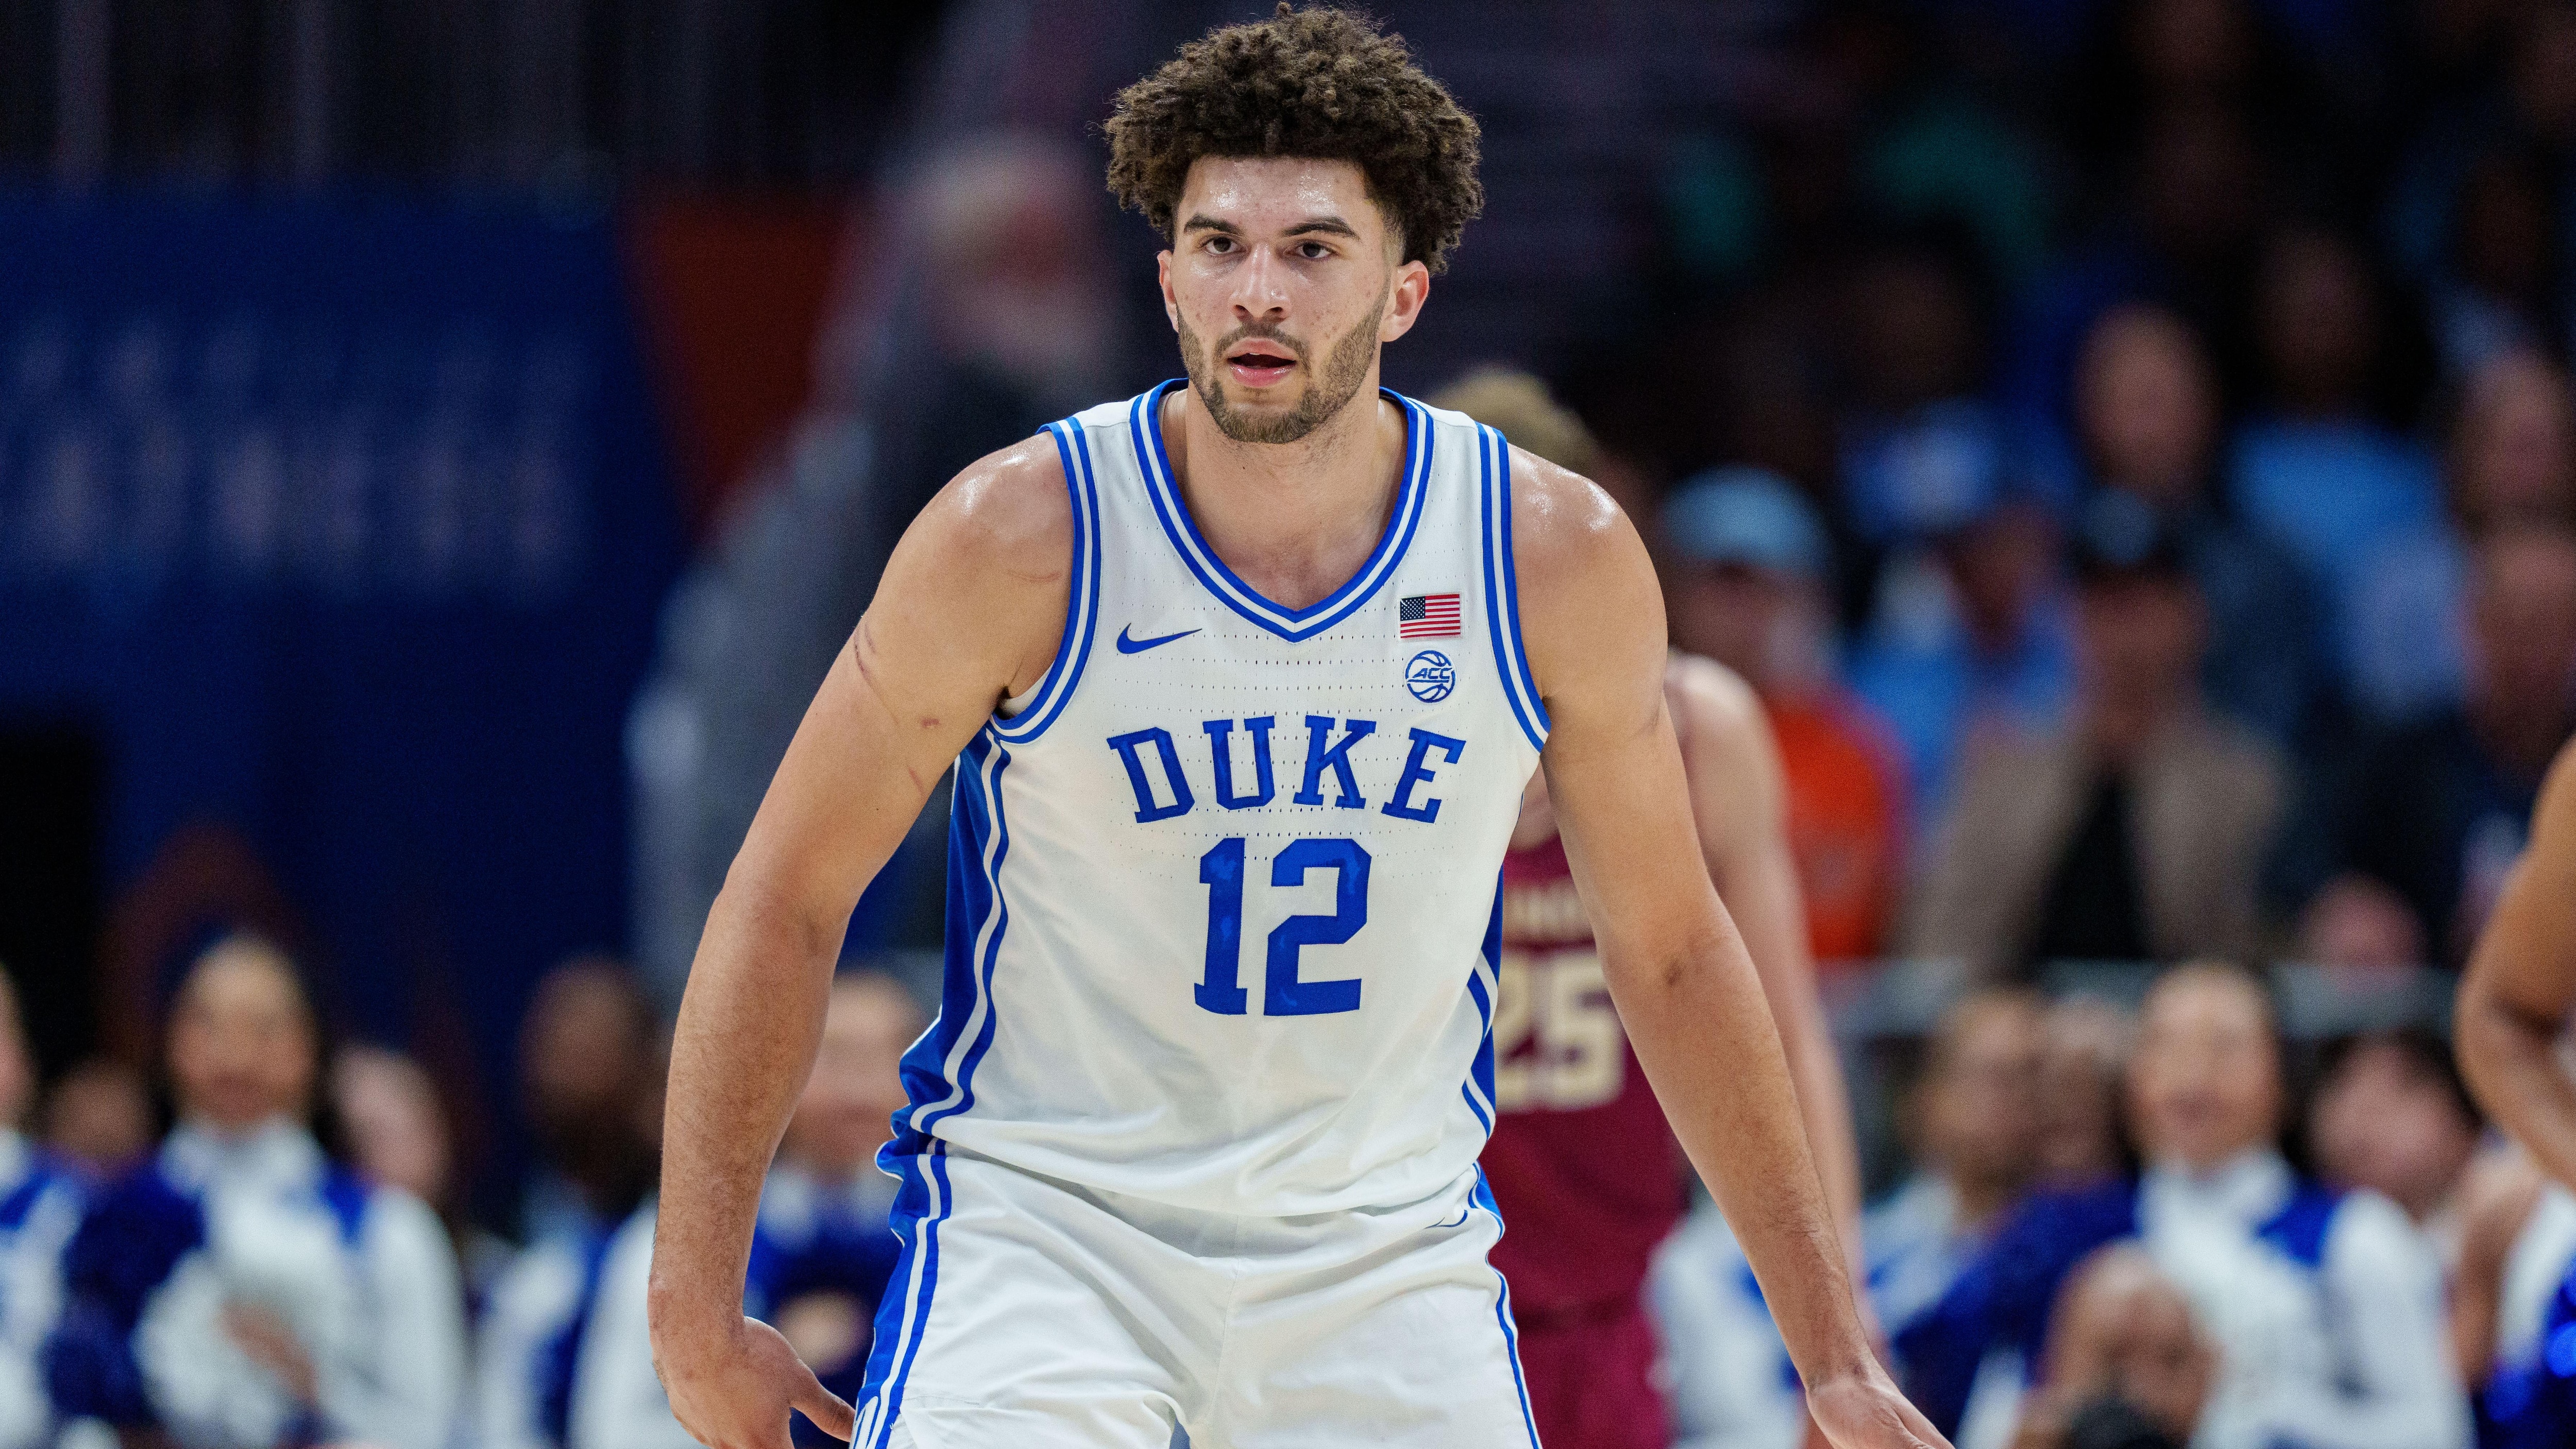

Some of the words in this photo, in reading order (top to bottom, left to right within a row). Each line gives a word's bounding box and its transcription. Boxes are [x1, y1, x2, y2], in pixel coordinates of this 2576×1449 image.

[1412, 668, 1452, 679] ACC
[1107, 715, 1466, 823] DUKE
[1195, 838, 1371, 1016] 12
[1494, 950, 1627, 1113] 25
